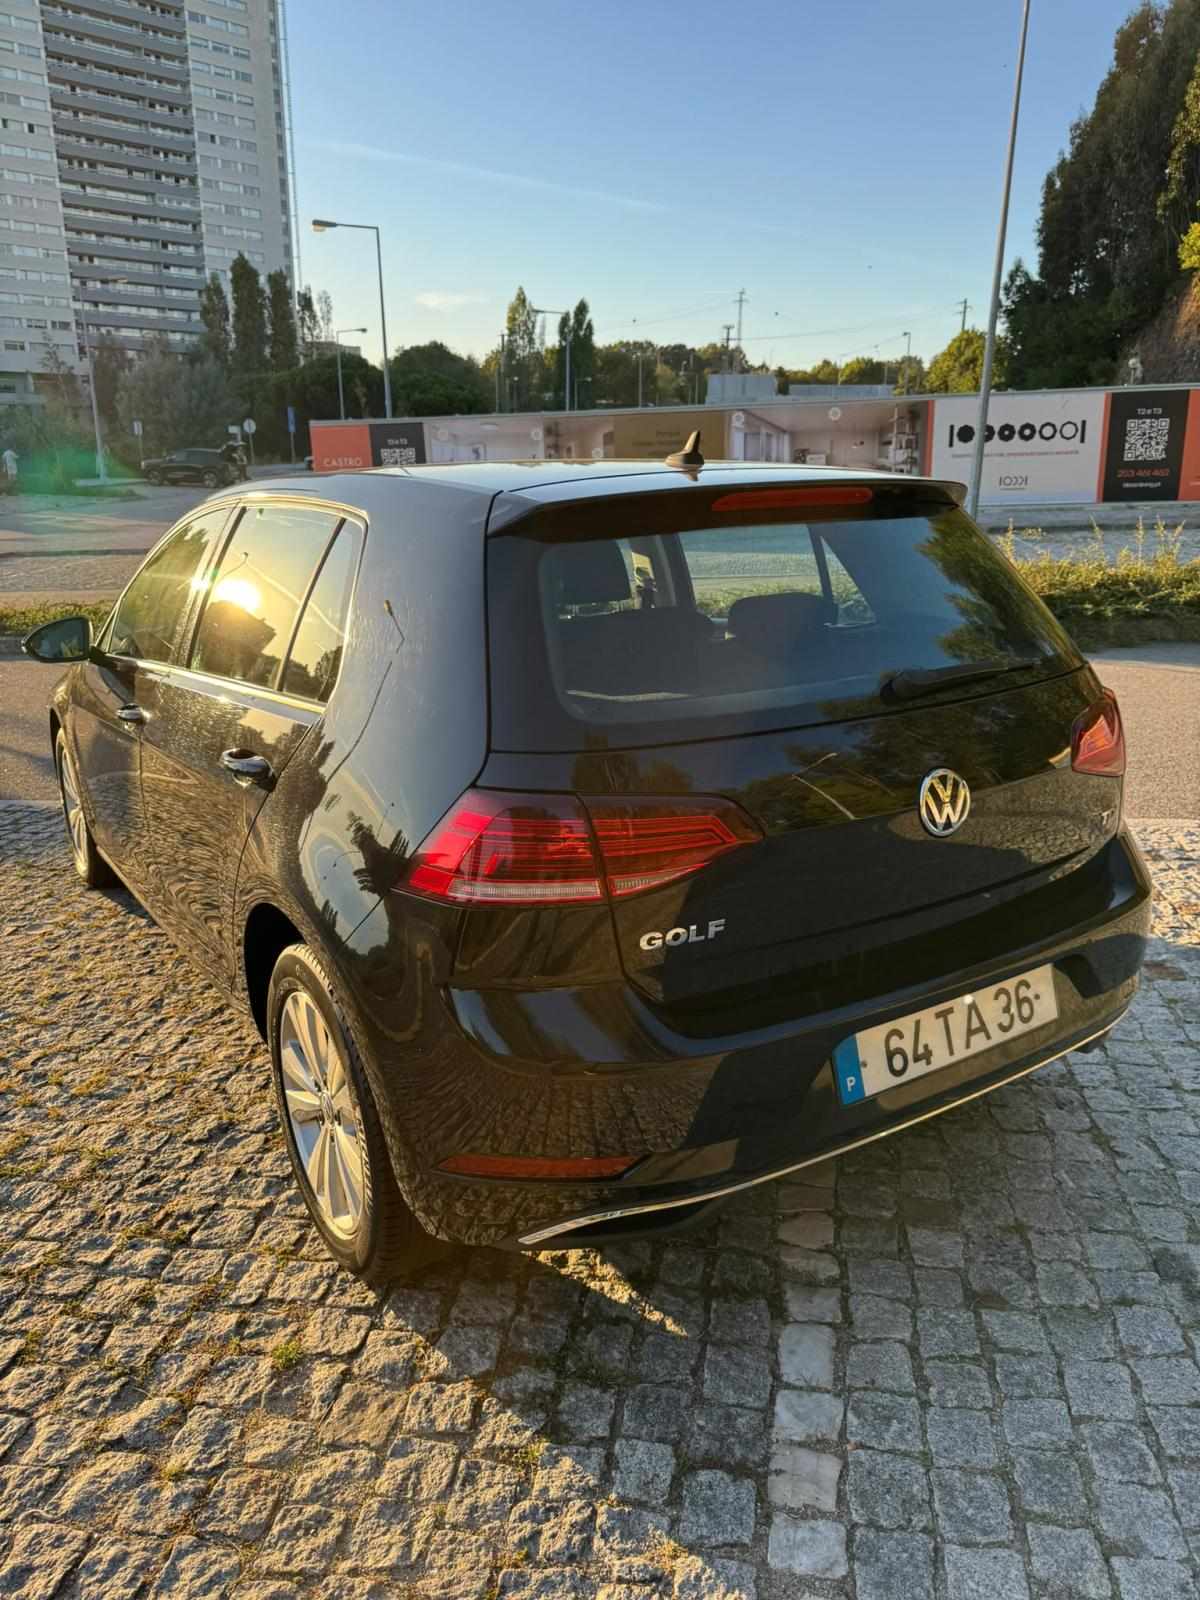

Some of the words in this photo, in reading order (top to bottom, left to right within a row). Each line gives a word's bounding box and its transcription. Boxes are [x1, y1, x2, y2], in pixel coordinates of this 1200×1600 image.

[323, 457, 362, 466] CASTRO
[922, 770, 968, 833] VW
[639, 918, 726, 951] GOLF
[846, 1076, 856, 1092] P
